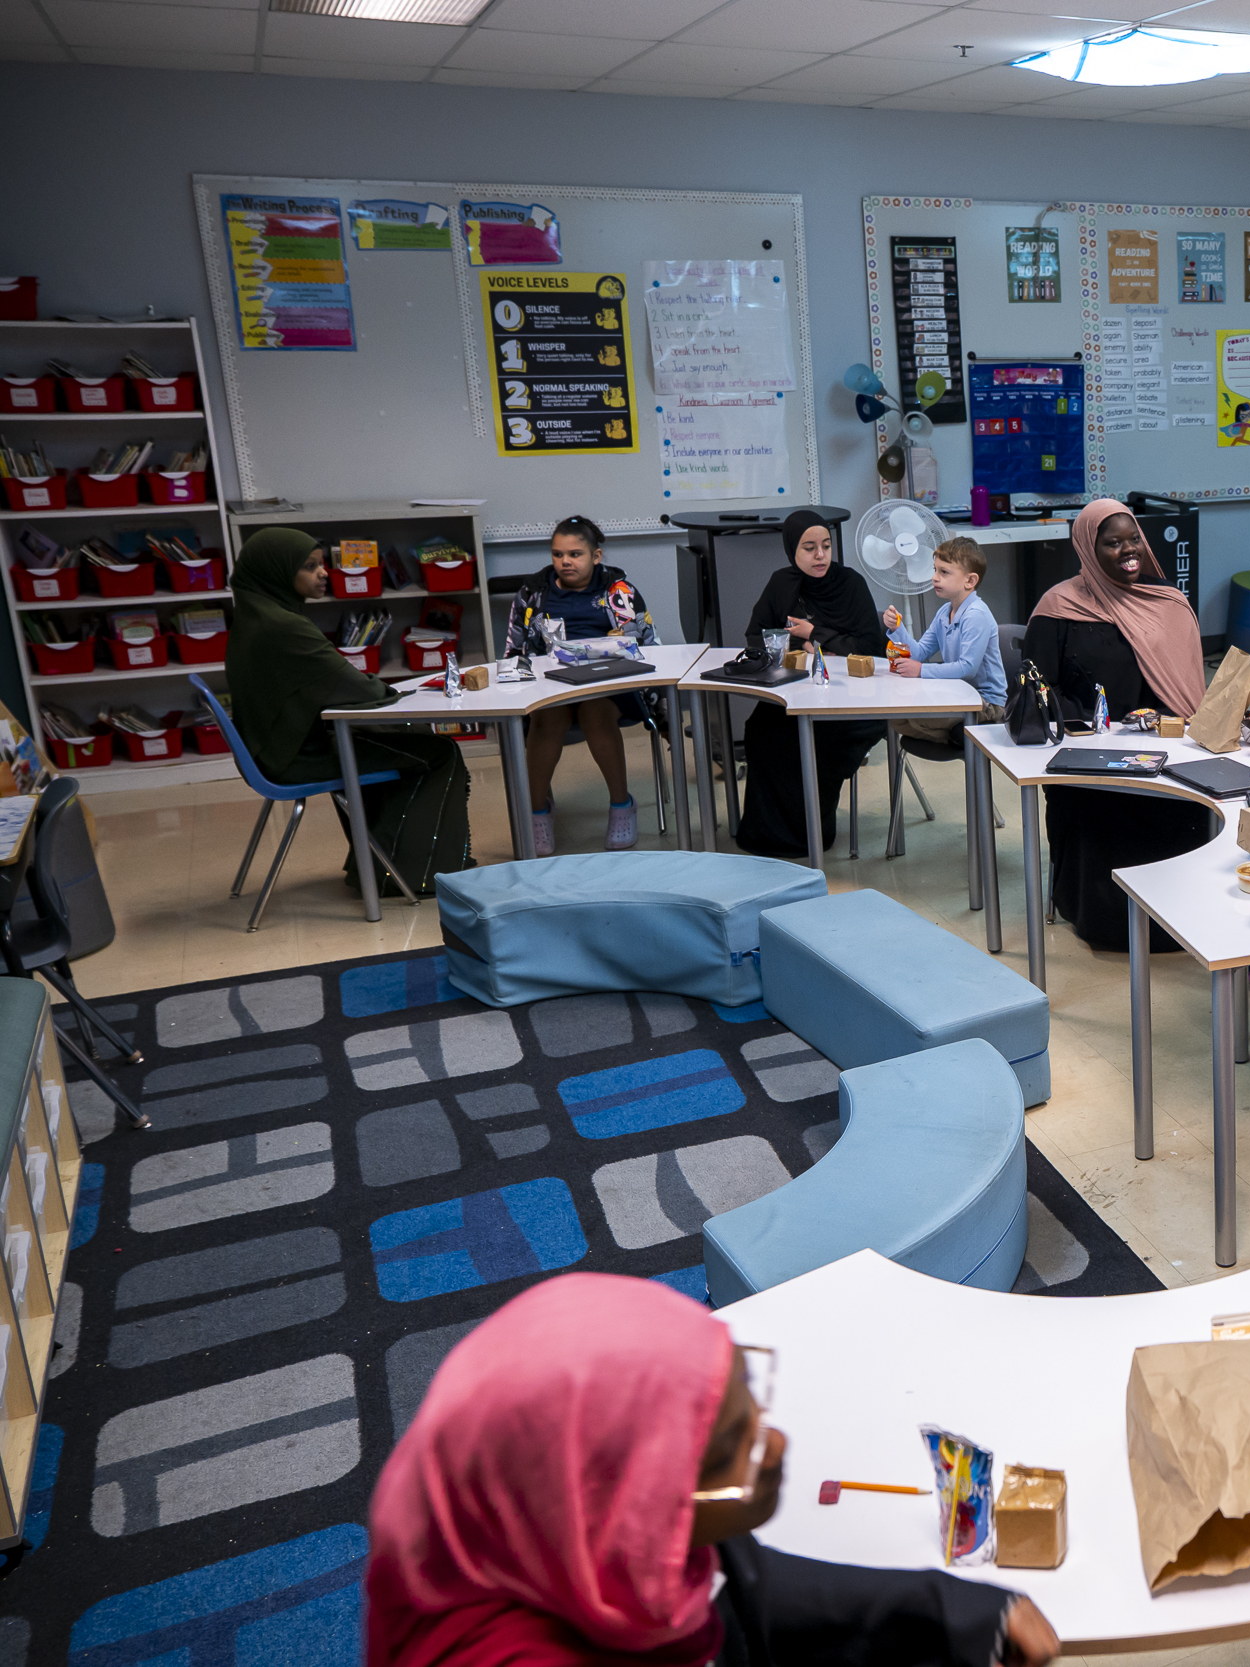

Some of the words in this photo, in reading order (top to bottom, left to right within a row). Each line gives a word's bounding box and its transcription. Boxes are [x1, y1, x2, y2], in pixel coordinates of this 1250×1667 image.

[241, 197, 285, 213] Writing
[288, 200, 335, 215] Process
[463, 204, 525, 222] Publishing
[1182, 241, 1192, 250] SO
[1196, 241, 1221, 250] MANY
[1115, 248, 1150, 257] READING
[1111, 268, 1155, 277] ADVENTURE
[1201, 272, 1223, 282] TIME
[488, 277, 523, 288] VOICE
[527, 277, 569, 288] LEVELS
[656, 292, 682, 305] Respect
[686, 292, 697, 303] the
[494, 300, 521, 328] 0
[525, 305, 560, 313] SILENCE
[1125, 305, 1150, 315] Spelling
[662, 310, 674, 321] Sit
[1133, 320, 1156, 328] deposit
[666, 328, 684, 339] Listen
[687, 327, 705, 338] from
[705, 327, 716, 337] the
[1104, 333, 1122, 341] again
[528, 343, 566, 351] WHISPER
[1227, 338, 1249, 346] TODAY'S
[693, 344, 710, 356] from
[712, 345, 721, 354] the
[1134, 344, 1152, 352] ability
[500, 339, 523, 369] 1
[672, 360, 686, 373] Just
[690, 365, 701, 375] say
[1018, 370, 1037, 382] May
[1133, 369, 1161, 378] probably
[533, 384, 567, 392] NORMAL
[1104, 382, 1133, 390] company
[1137, 381, 1160, 390] elegant
[505, 381, 528, 406] 2
[679, 394, 708, 406] Kindness
[712, 394, 743, 406] Classroom
[748, 393, 776, 408] Agreement
[1073, 403, 1078, 411] 2
[1137, 408, 1165, 416] sentence
[667, 411, 675, 424] Be
[679, 412, 694, 424] kind
[1106, 408, 1132, 417] distance
[537, 420, 572, 429] OUTSIDE
[1175, 416, 1205, 425] glistening
[507, 417, 532, 444] 3
[980, 423, 985, 431] 3
[1012, 421, 1017, 429] 5
[1106, 423, 1132, 432] problem
[670, 428, 694, 441] Respect
[696, 432, 720, 442] everyone
[672, 444, 696, 457] Include
[698, 448, 722, 458] everyone
[732, 448, 742, 456] our
[744, 444, 772, 456] activities
[675, 462, 688, 473] Use
[690, 462, 707, 472] kind
[709, 462, 728, 473] words
[1045, 459, 1053, 467] 21
[421, 546, 459, 560] Survival
